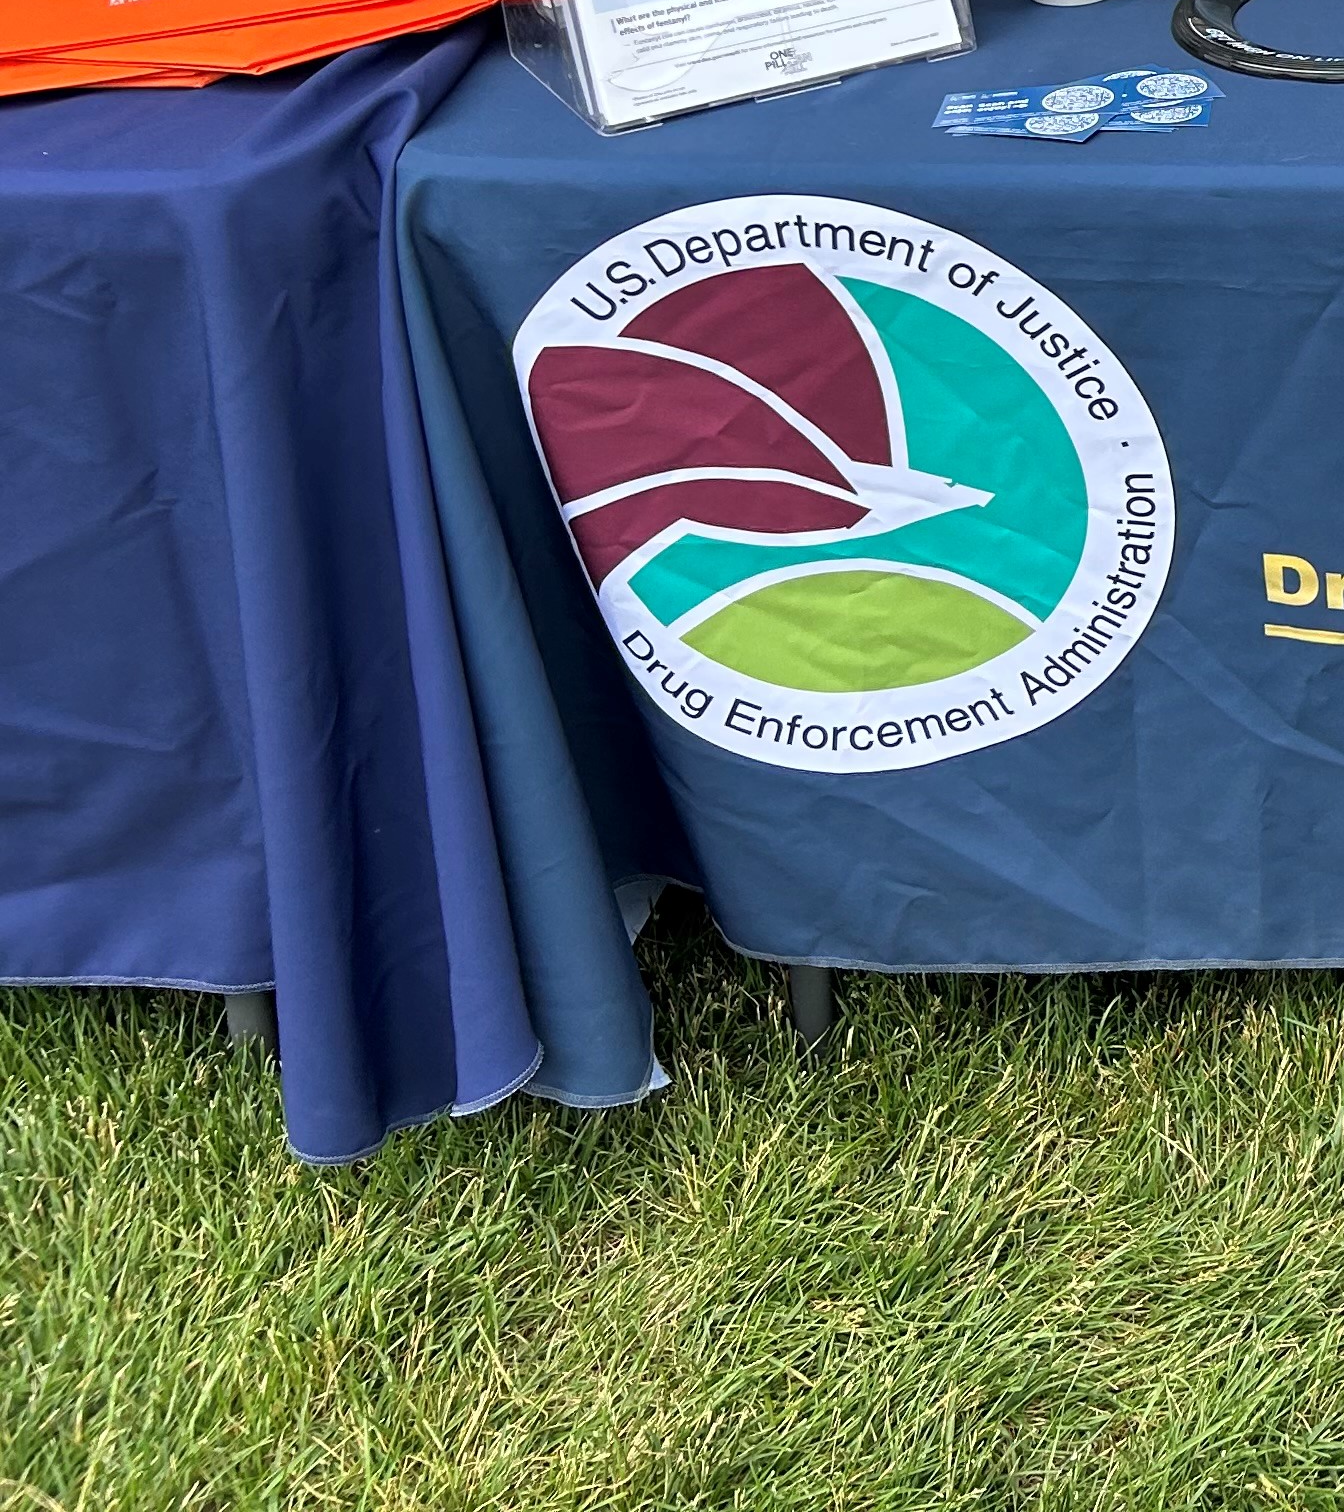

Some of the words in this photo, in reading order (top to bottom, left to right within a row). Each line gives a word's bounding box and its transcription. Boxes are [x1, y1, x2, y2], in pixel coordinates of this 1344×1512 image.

[570, 260, 656, 323] U.S.
[645, 214, 937, 278] Department
[946, 259, 1004, 297] of
[995, 296, 1120, 423] Justice
[620, 629, 716, 719] Drug
[723, 686, 1015, 752] Enforcement
[1018, 471, 1156, 707] Administration
